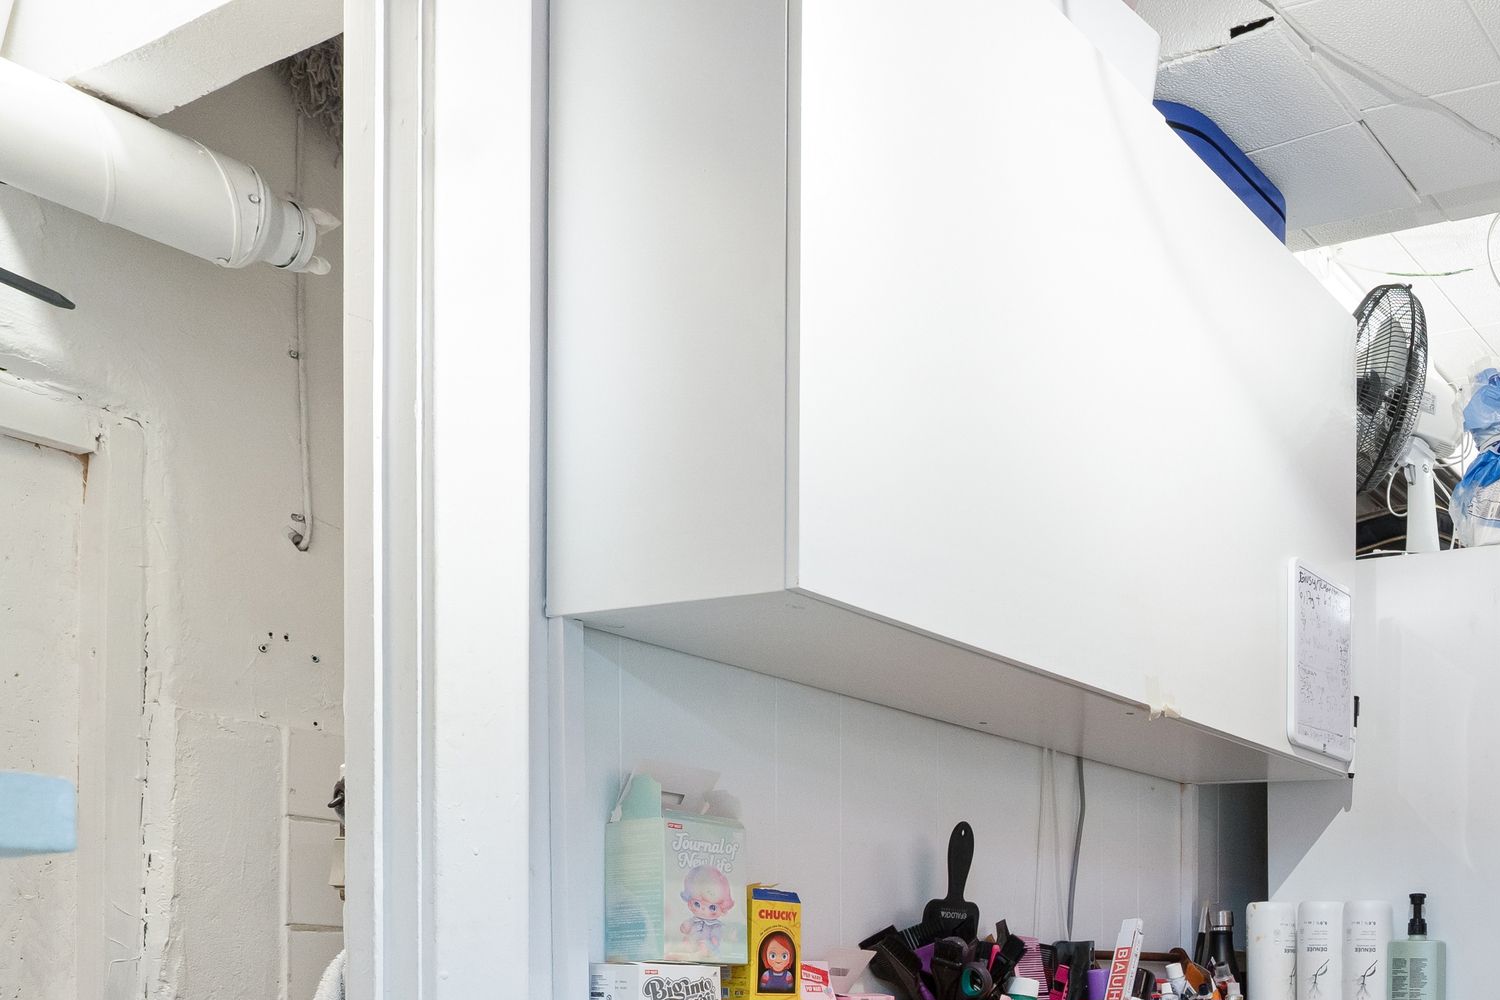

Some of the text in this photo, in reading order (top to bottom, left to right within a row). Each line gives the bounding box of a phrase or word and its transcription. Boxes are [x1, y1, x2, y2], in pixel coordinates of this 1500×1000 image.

[672, 832, 739, 860] Journal of
[678, 853, 732, 873] New Life
[758, 909, 797, 921] CHUCKY
[687, 979, 712, 996] into
